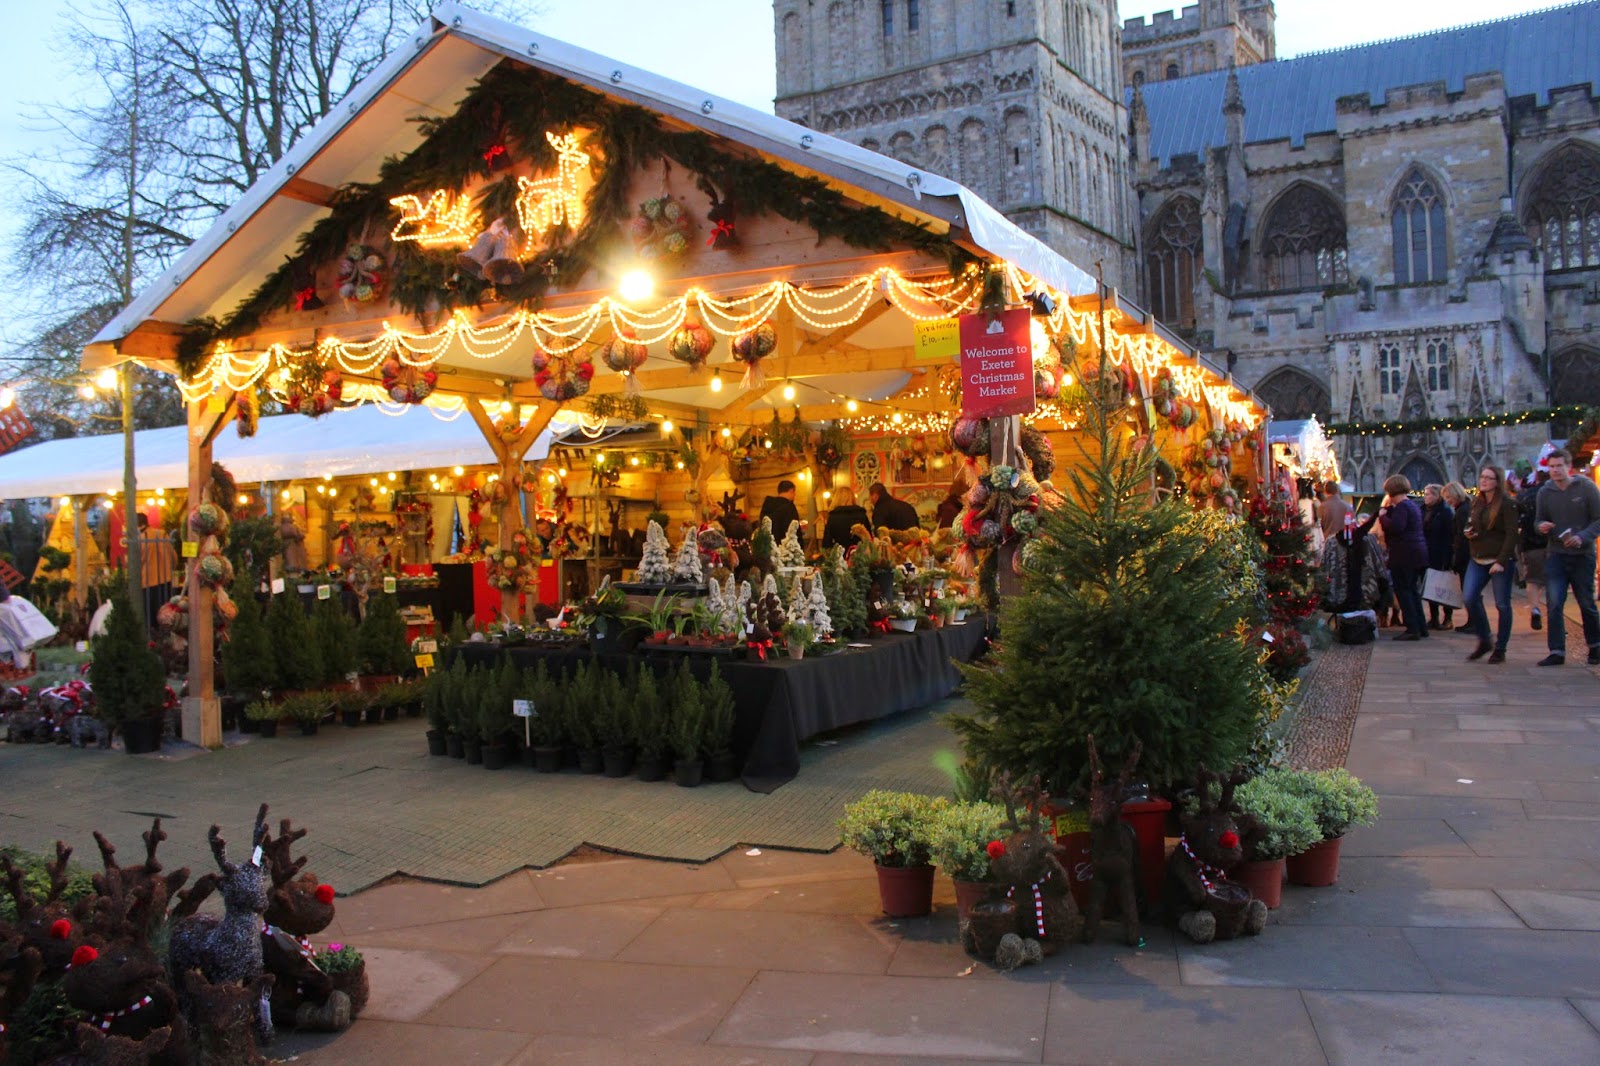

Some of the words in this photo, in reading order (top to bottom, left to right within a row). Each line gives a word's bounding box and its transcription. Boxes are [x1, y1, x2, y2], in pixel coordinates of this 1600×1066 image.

[965, 346, 1014, 359] Welcome
[1016, 345, 1028, 354] to
[981, 360, 1016, 371] Exeter
[970, 372, 1025, 385] Christmas
[979, 384, 1017, 397] Market
